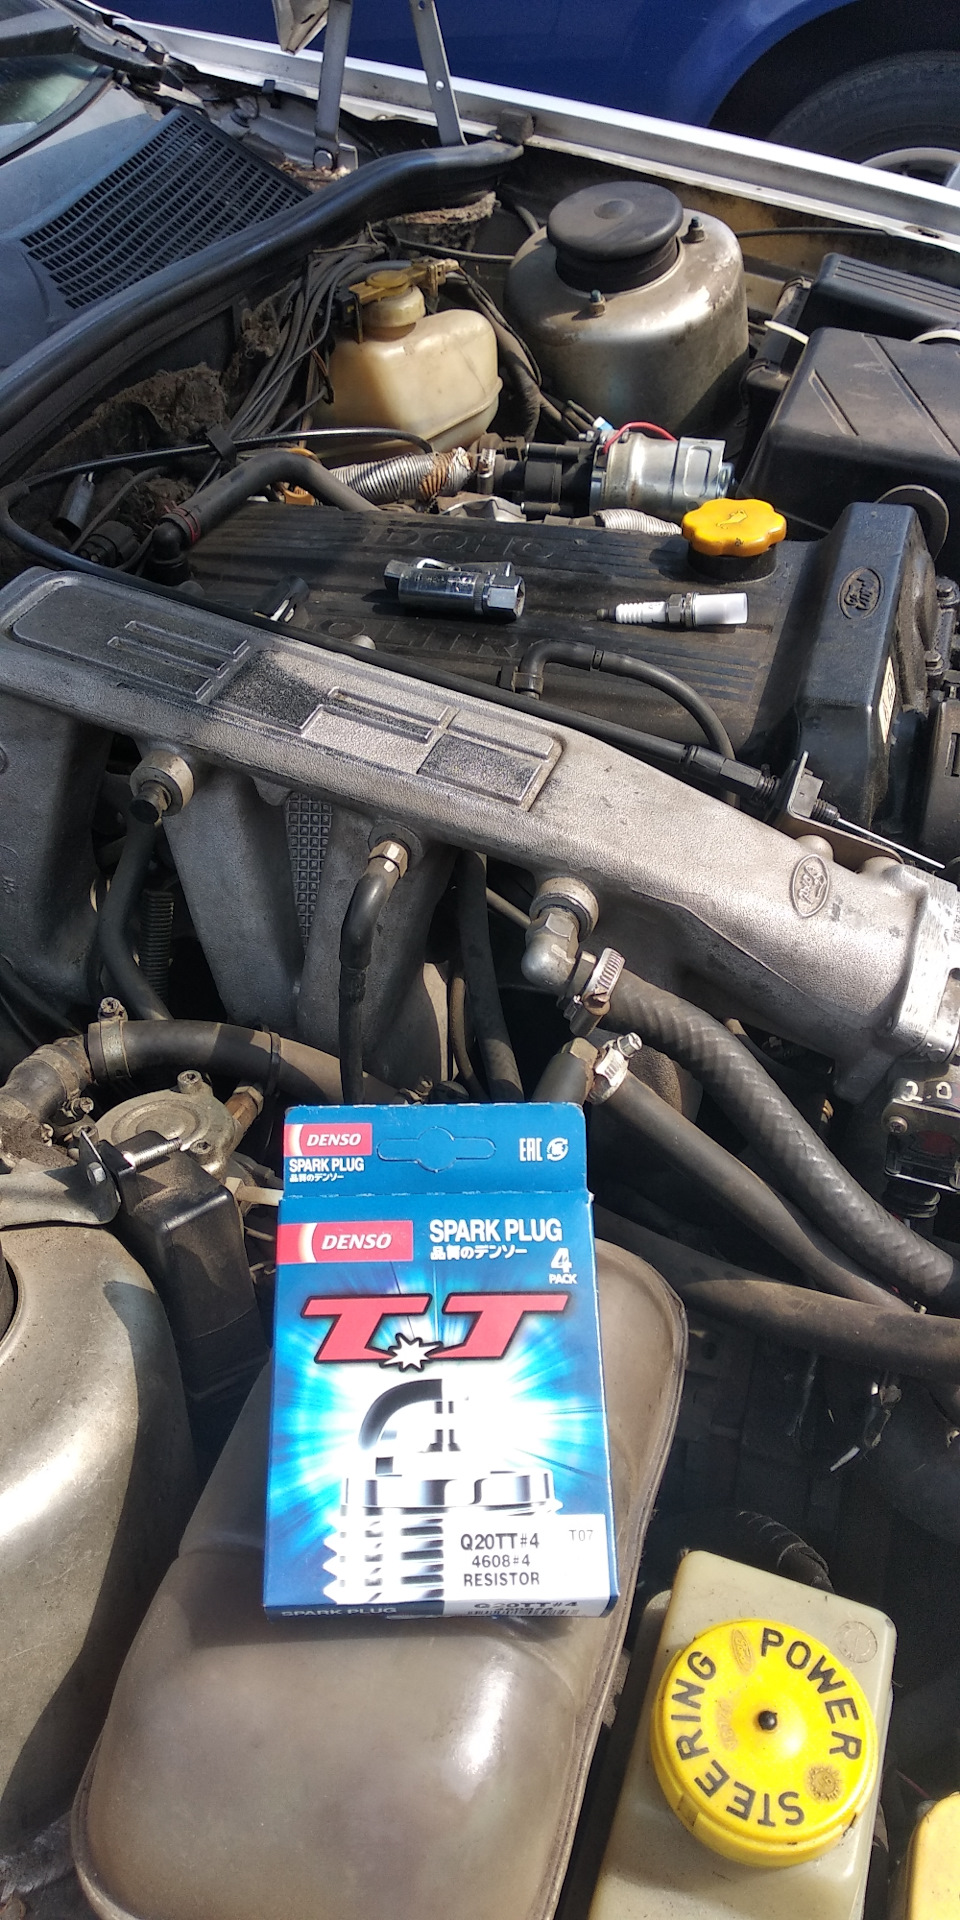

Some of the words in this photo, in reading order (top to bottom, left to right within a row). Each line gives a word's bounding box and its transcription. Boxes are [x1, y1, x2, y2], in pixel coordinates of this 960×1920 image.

[900, 1080, 953, 1102] 2.0
[306, 1133, 362, 1148] DENSO
[289, 1158, 330, 1173] SPARK
[331, 1157, 365, 1172] PLUG
[429, 1219, 501, 1243] SPARK
[505, 1218, 563, 1242] PLUG
[321, 1232, 392, 1251] DENSO
[550, 1248, 573, 1274] 4
[549, 1273, 578, 1285] PACK
[460, 1532, 540, 1551] Q20TT#4
[568, 1529, 594, 1542] T07
[472, 1554, 531, 1568] 4608#4
[463, 1572, 541, 1587] RESISTOR
[281, 1609, 342, 1617] SPARK
[347, 1607, 398, 1615] PLUG
[760, 1627, 863, 1760] POWER
[671, 1651, 805, 1827] STEERING
